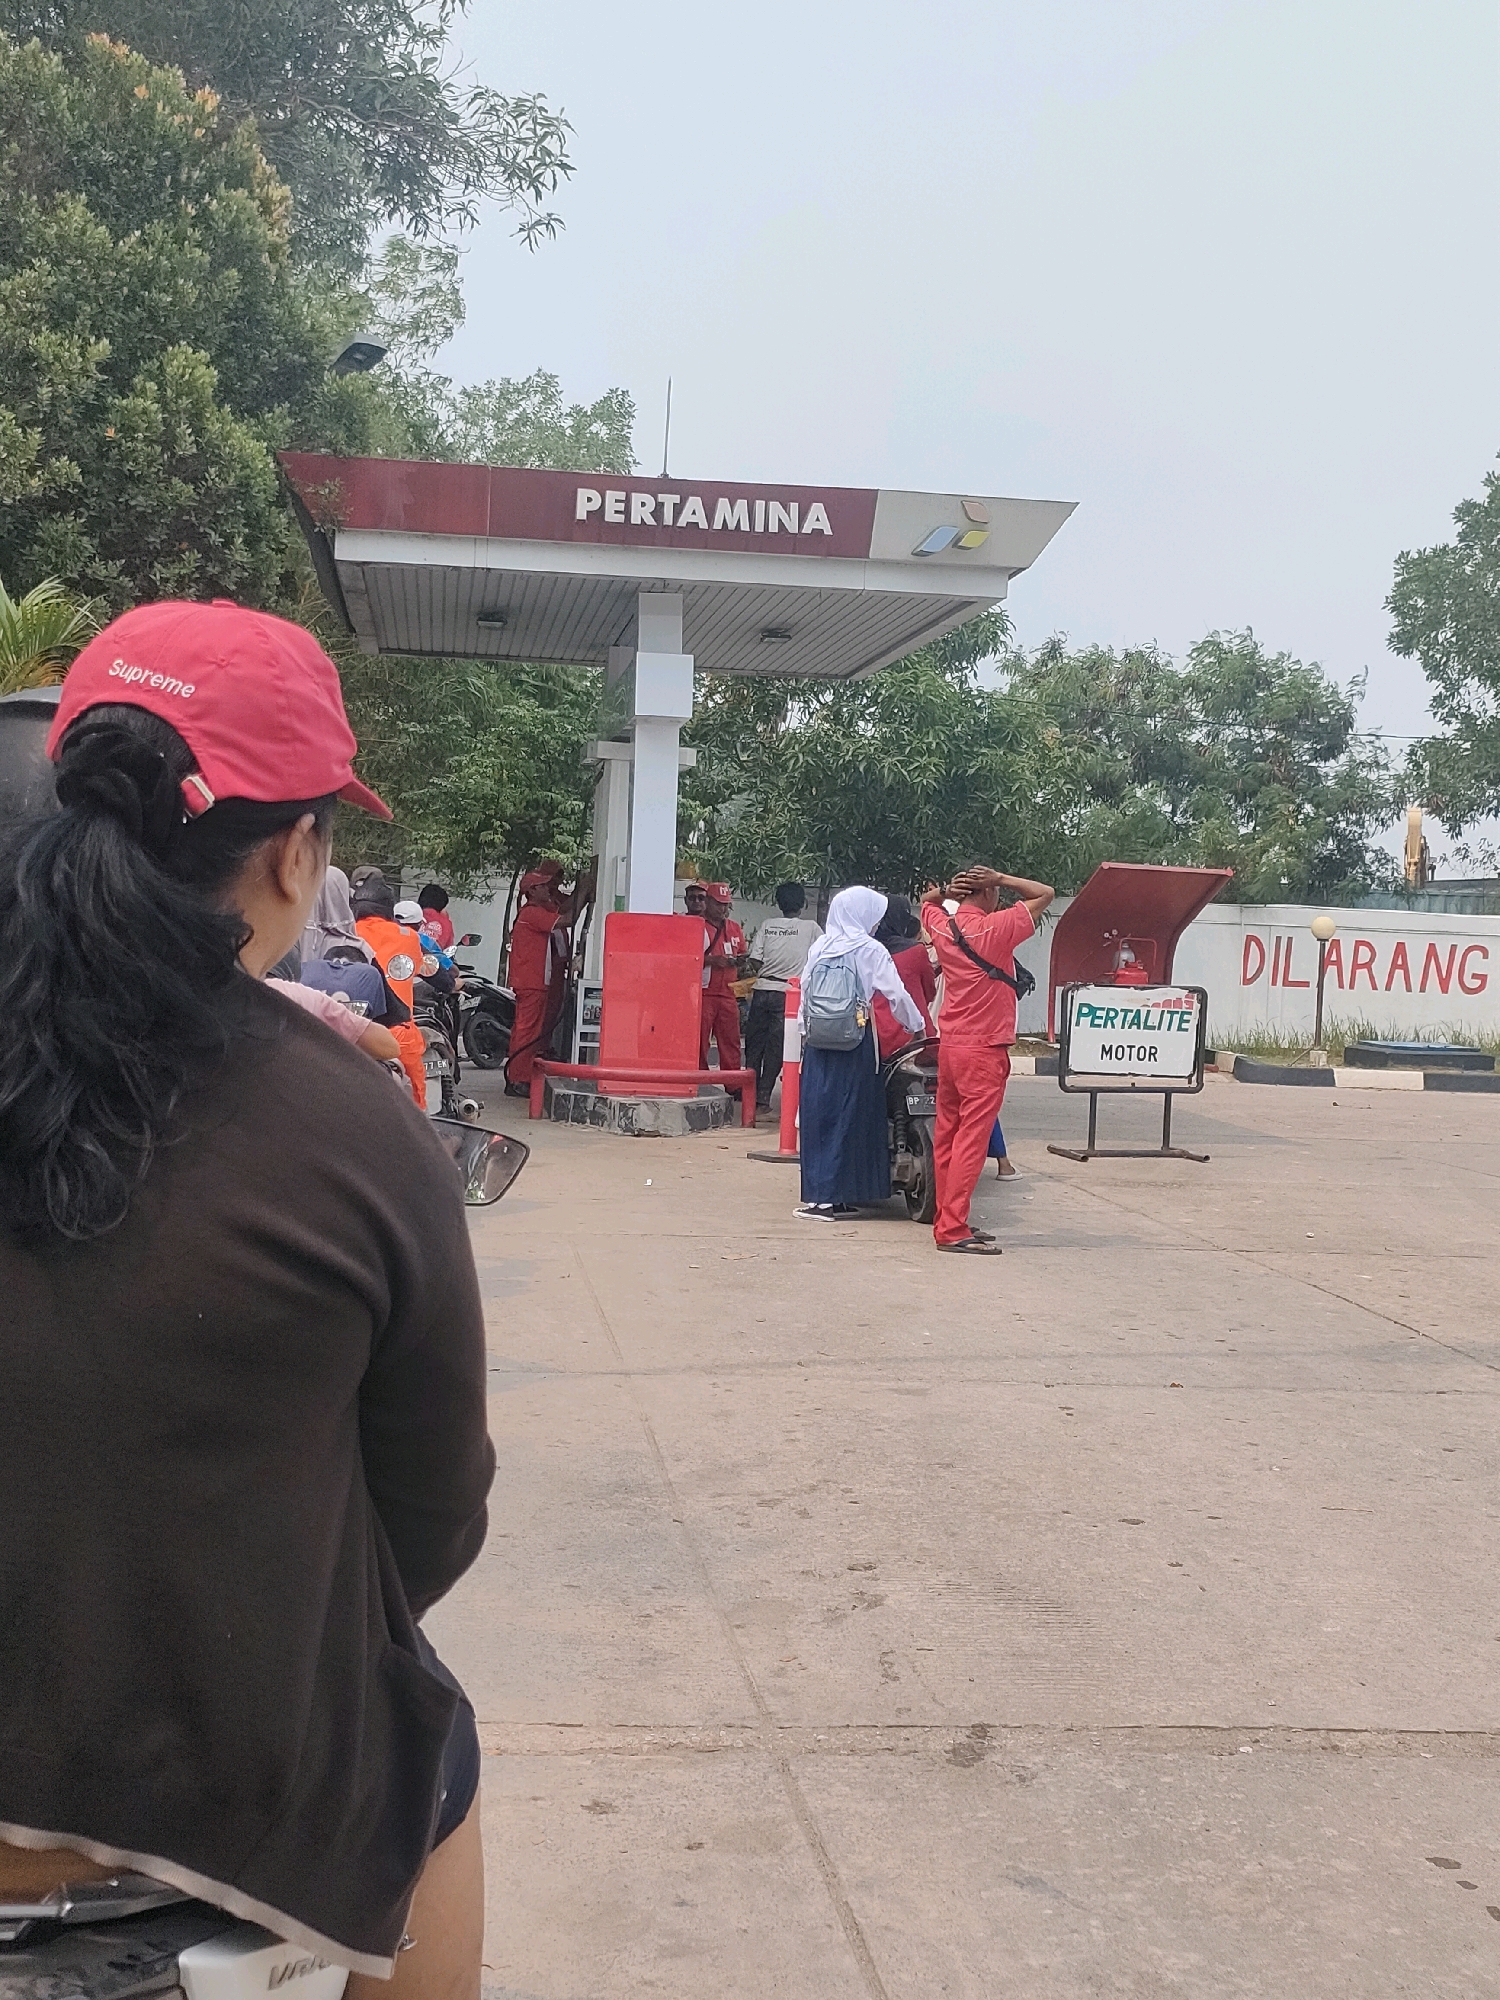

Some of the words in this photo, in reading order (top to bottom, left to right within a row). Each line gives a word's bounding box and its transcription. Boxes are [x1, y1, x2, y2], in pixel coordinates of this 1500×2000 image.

[576, 488, 833, 536] PERTAMINA
[108, 659, 196, 699] Supreme
[1241, 934, 1490, 996] DILARANG
[1075, 1002, 1193, 1033] PERTALITE
[1100, 1043, 1159, 1062] MOTOR
[908, 1096, 920, 1105] BP
